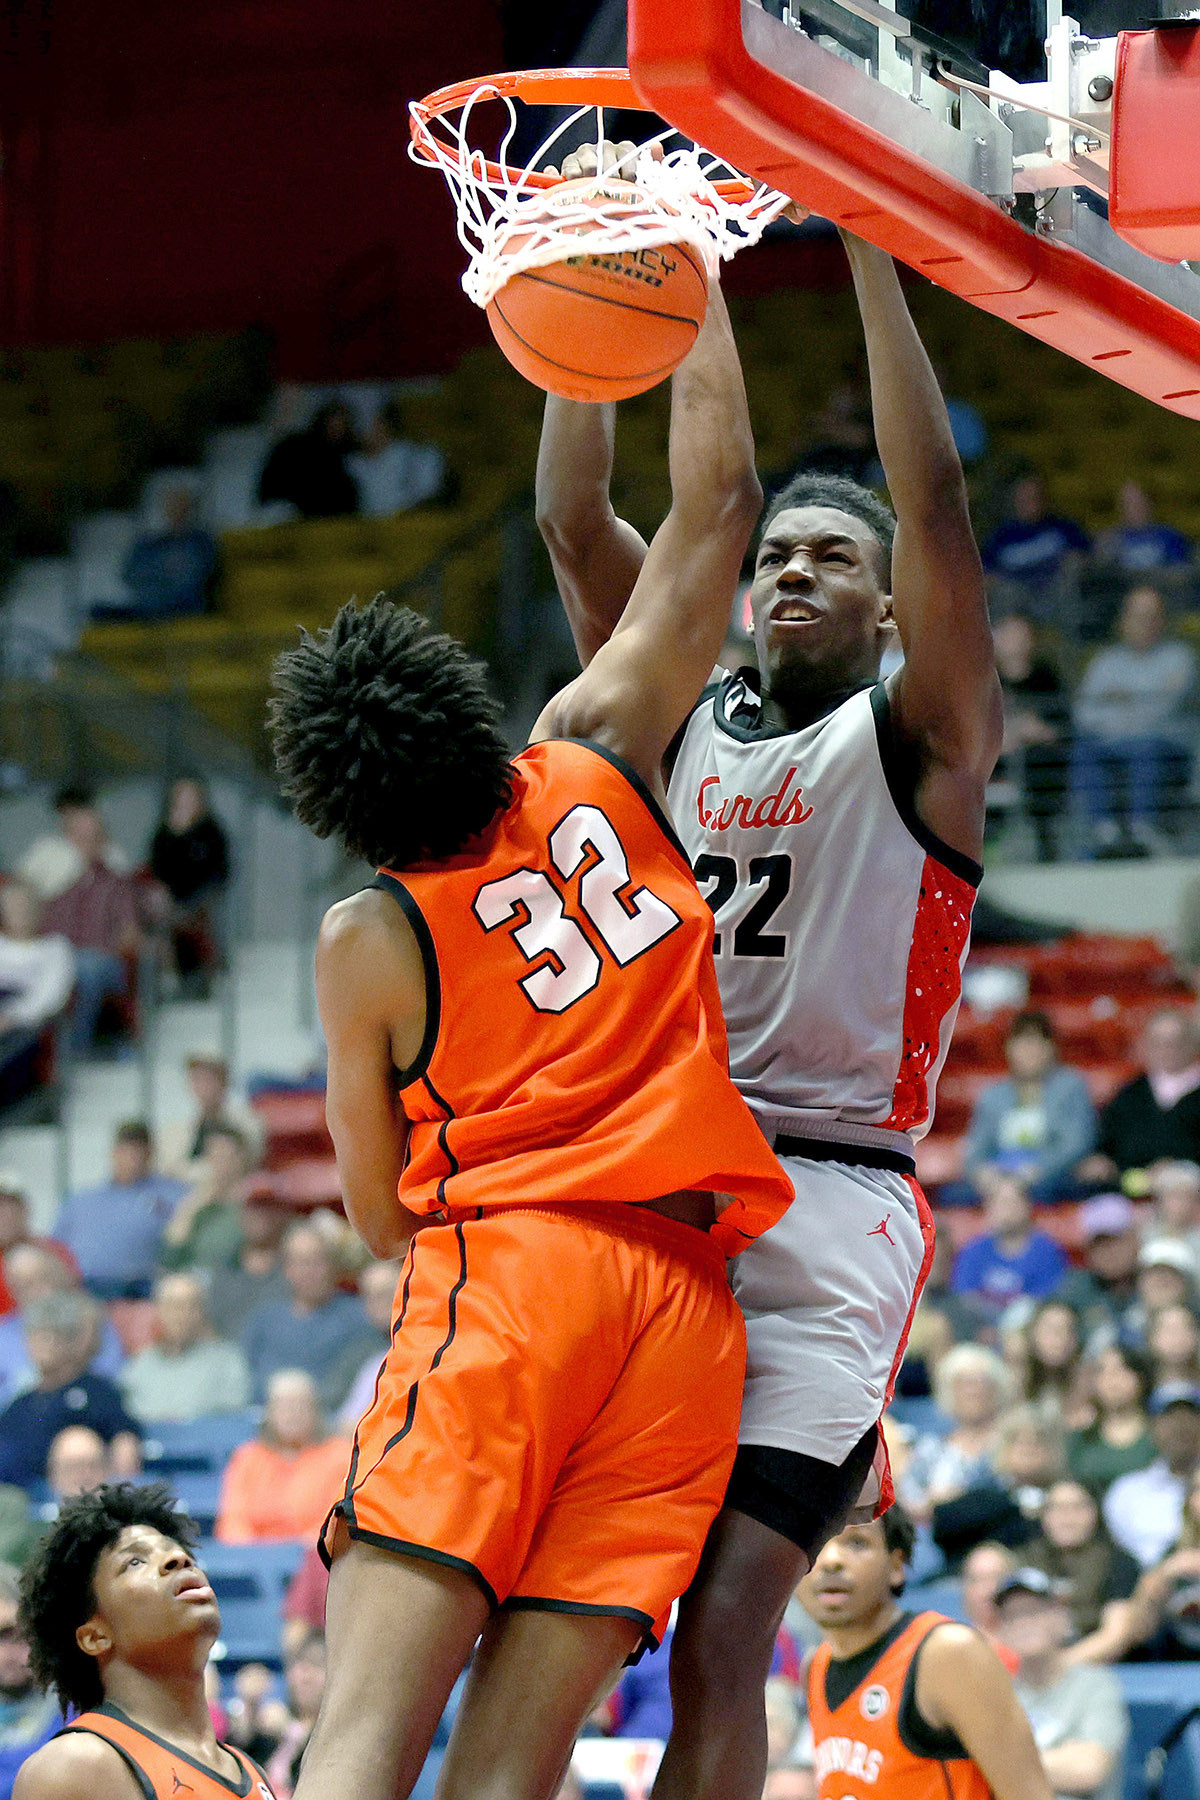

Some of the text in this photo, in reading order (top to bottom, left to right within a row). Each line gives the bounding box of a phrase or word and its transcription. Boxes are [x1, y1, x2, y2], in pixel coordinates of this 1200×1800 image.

[696, 765, 815, 831] Cards
[471, 803, 683, 1015] 32
[692, 852, 796, 958] 22
